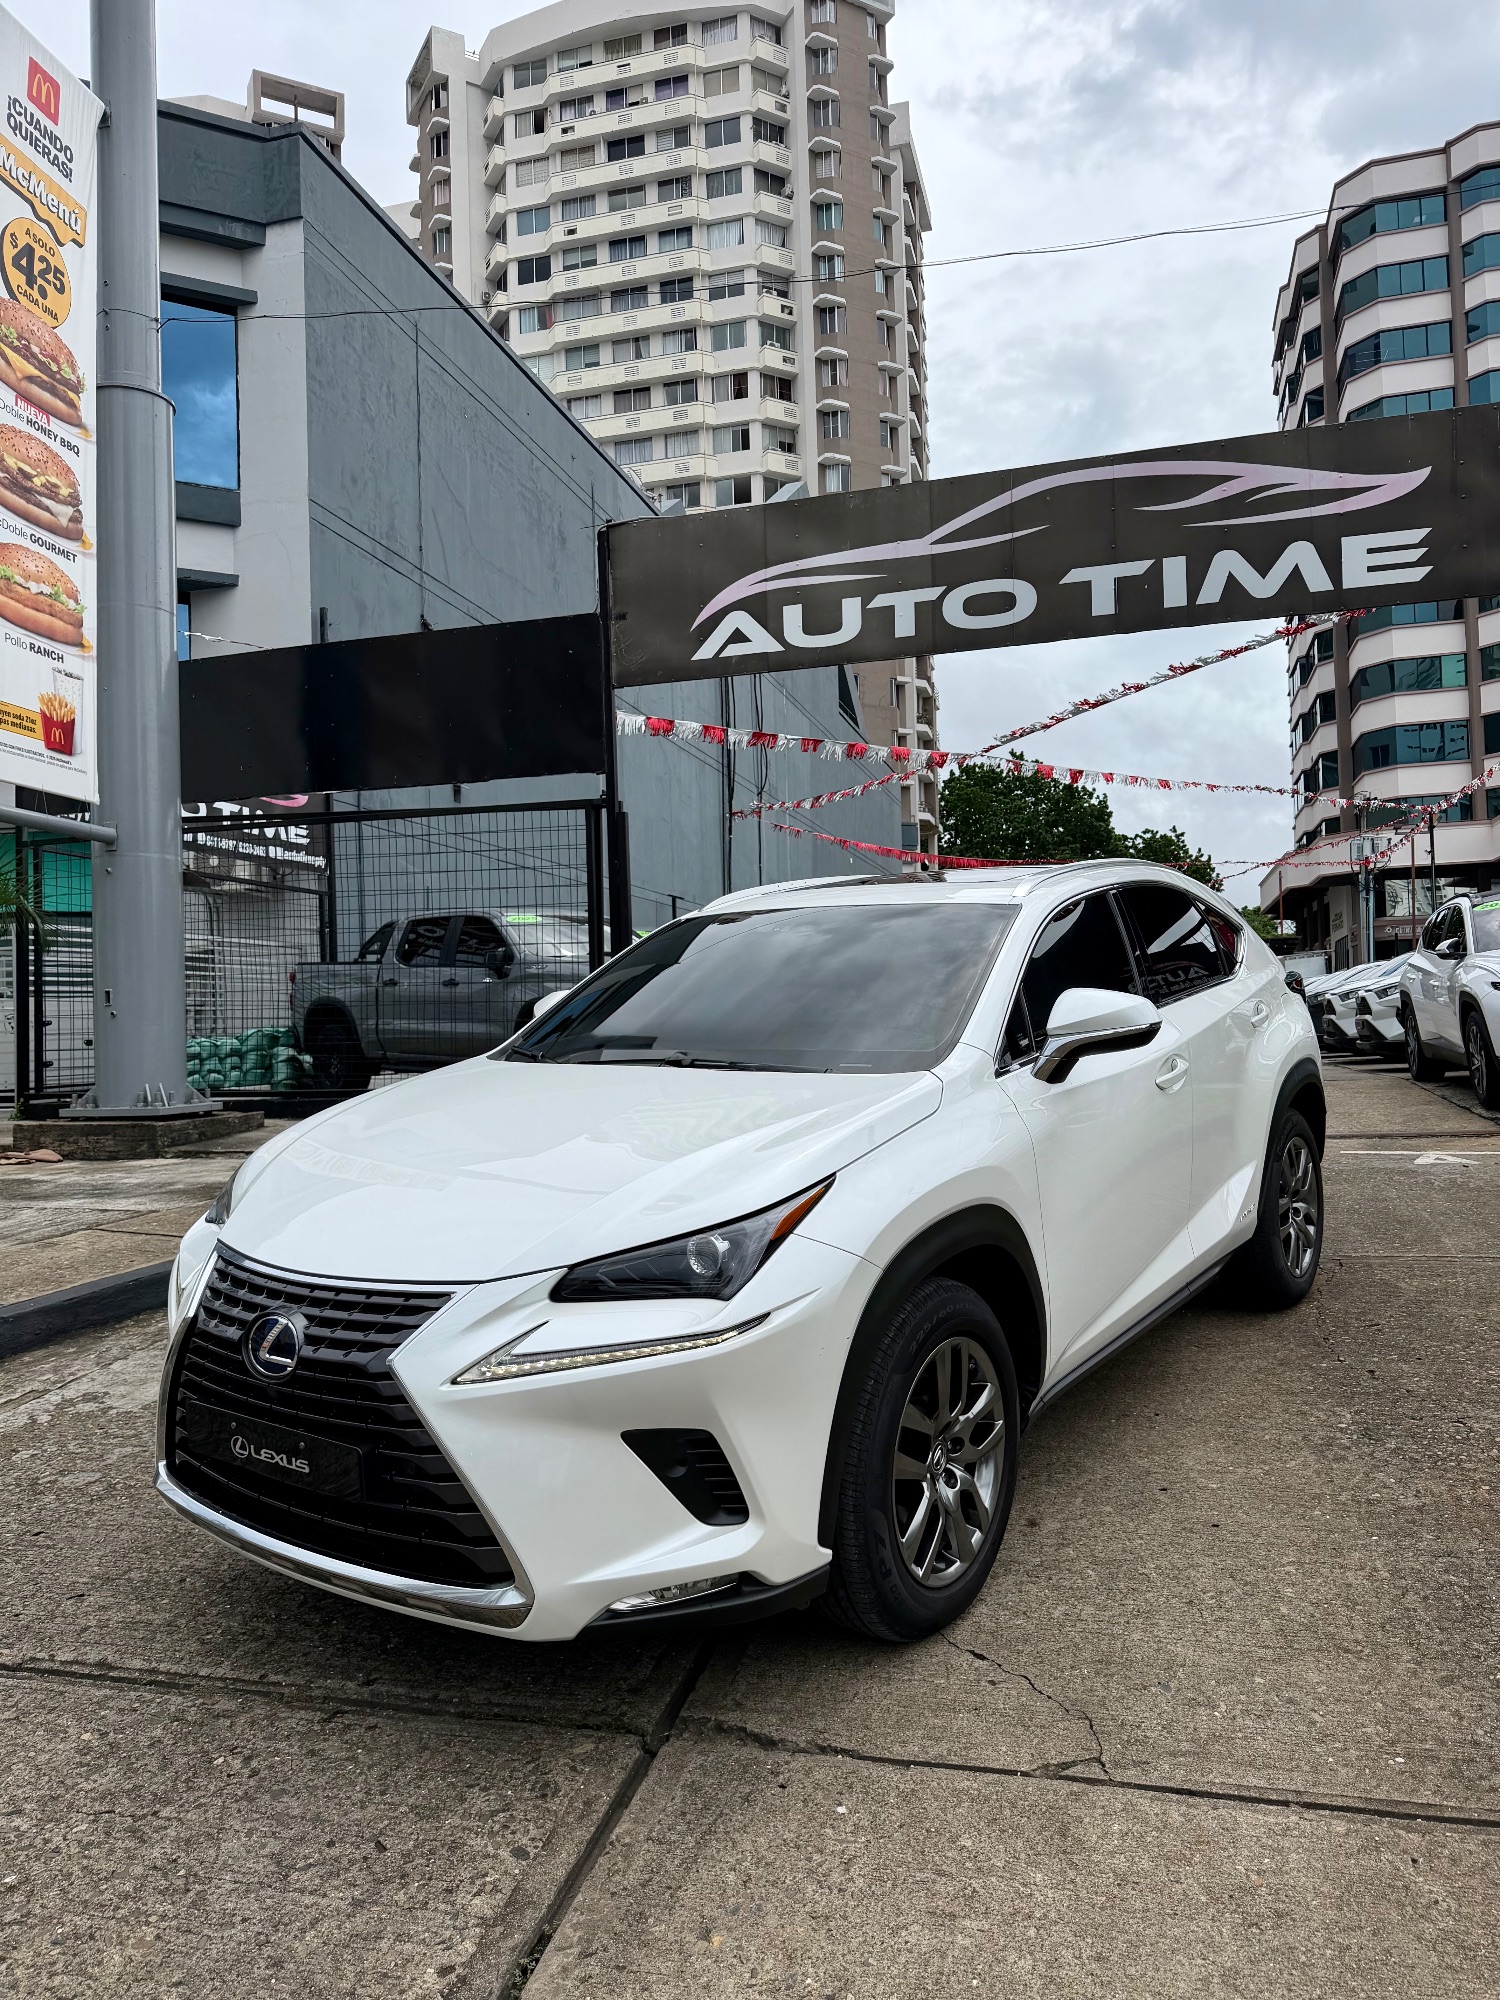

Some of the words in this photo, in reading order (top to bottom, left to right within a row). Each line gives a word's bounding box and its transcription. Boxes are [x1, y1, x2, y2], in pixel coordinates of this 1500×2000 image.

[6, 112, 73, 183] QUIERAS!
[7, 94, 74, 164] ¡CUANDO
[0, 144, 81, 236] McMenú
[16, 284, 41, 309] CADA
[41, 303, 59, 323] UNA
[17, 397, 49, 426] NUEVA
[26, 415, 59, 443] HONEY
[60, 436, 80, 458] BBQ
[30, 533, 78, 564] GOURMET
[690, 578, 1038, 661] AUTO
[1058, 527, 1434, 617] TIME
[4, 632, 28, 650] Pollo
[29, 641, 65, 664] RANCH
[250, 1444, 310, 1473] LEXUS
